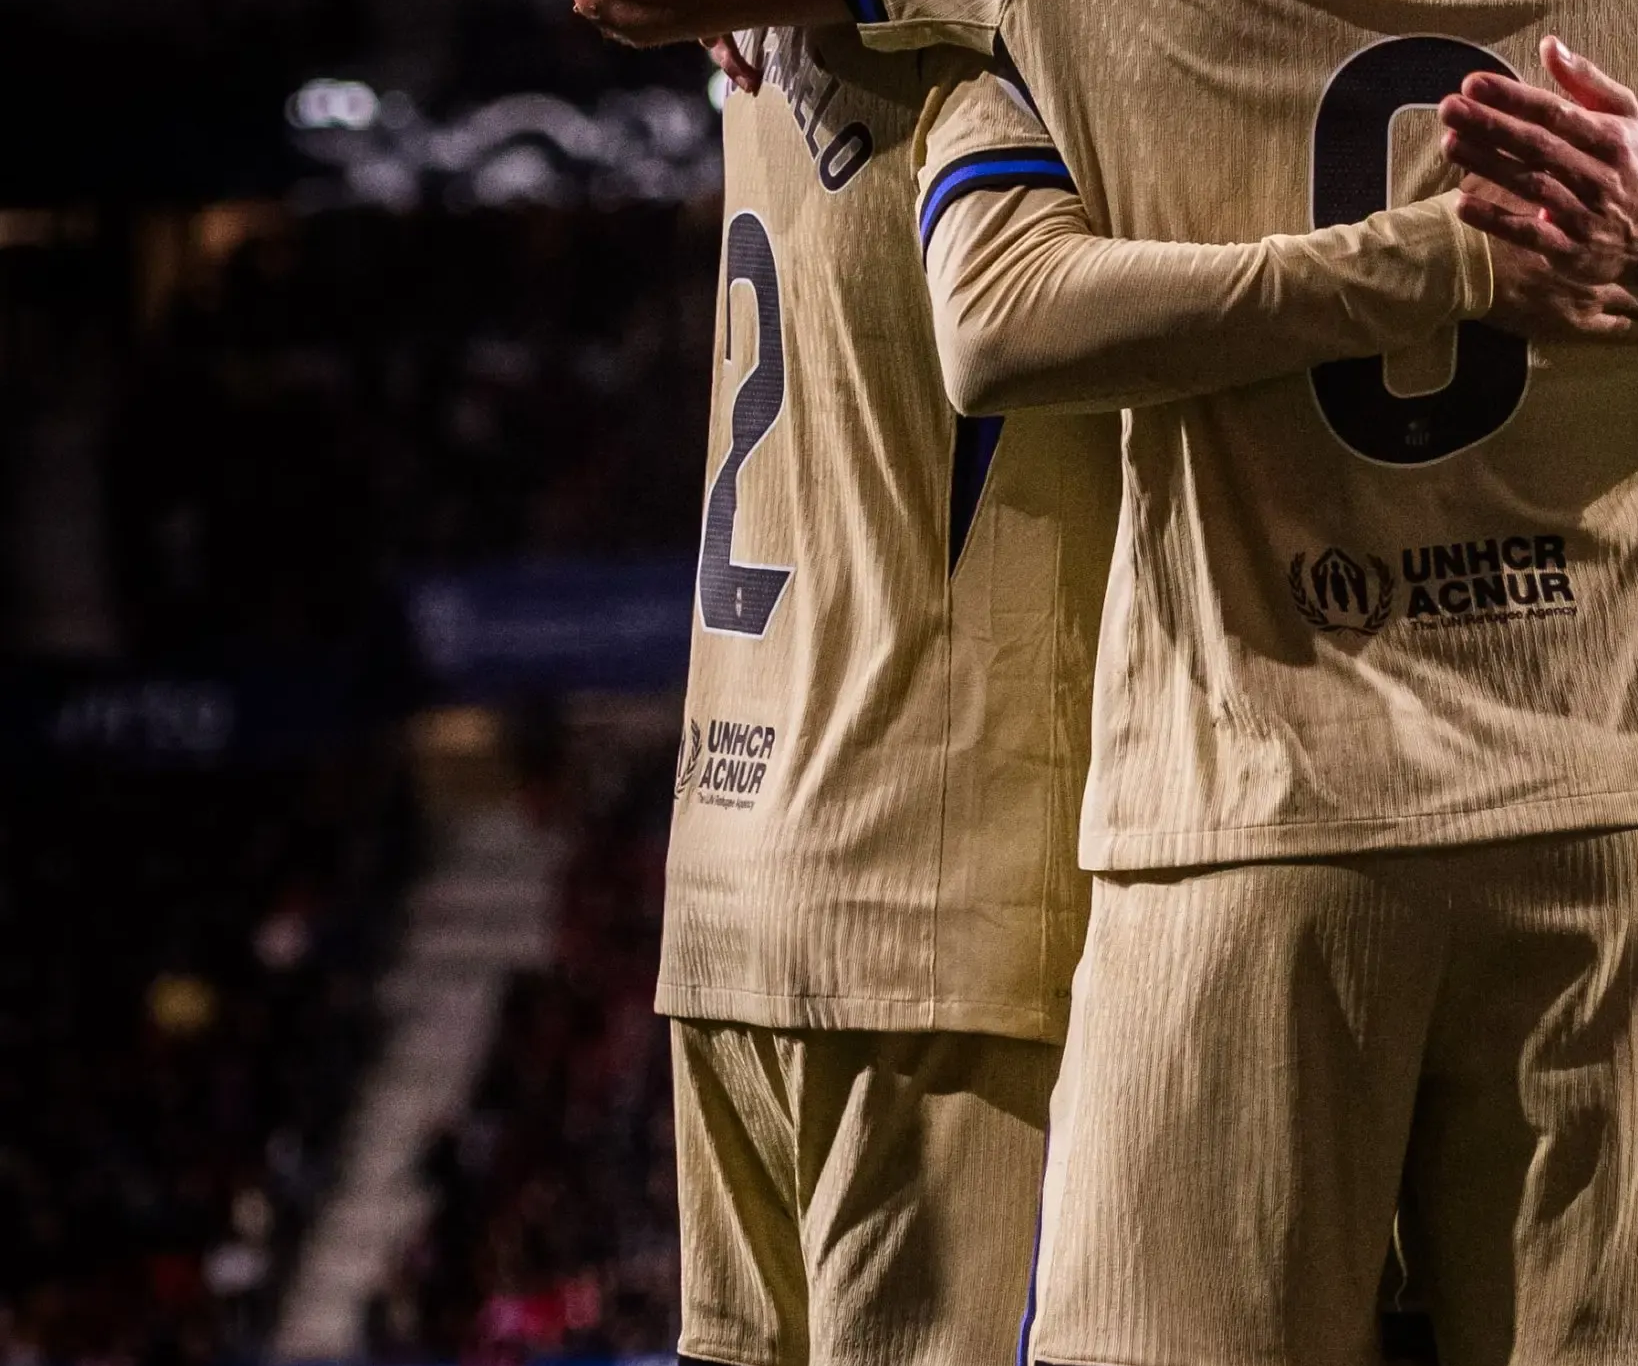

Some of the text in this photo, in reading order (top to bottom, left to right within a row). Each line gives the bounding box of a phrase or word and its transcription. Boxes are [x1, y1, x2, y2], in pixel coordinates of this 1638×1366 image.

[695, 208, 796, 640] 2
[1402, 535, 1566, 583] UNHCR
[1406, 572, 1575, 618] ACNUR
[1526, 606, 1578, 621] Agency
[707, 719, 776, 760] UNHCR
[698, 757, 767, 795] ACNUR
